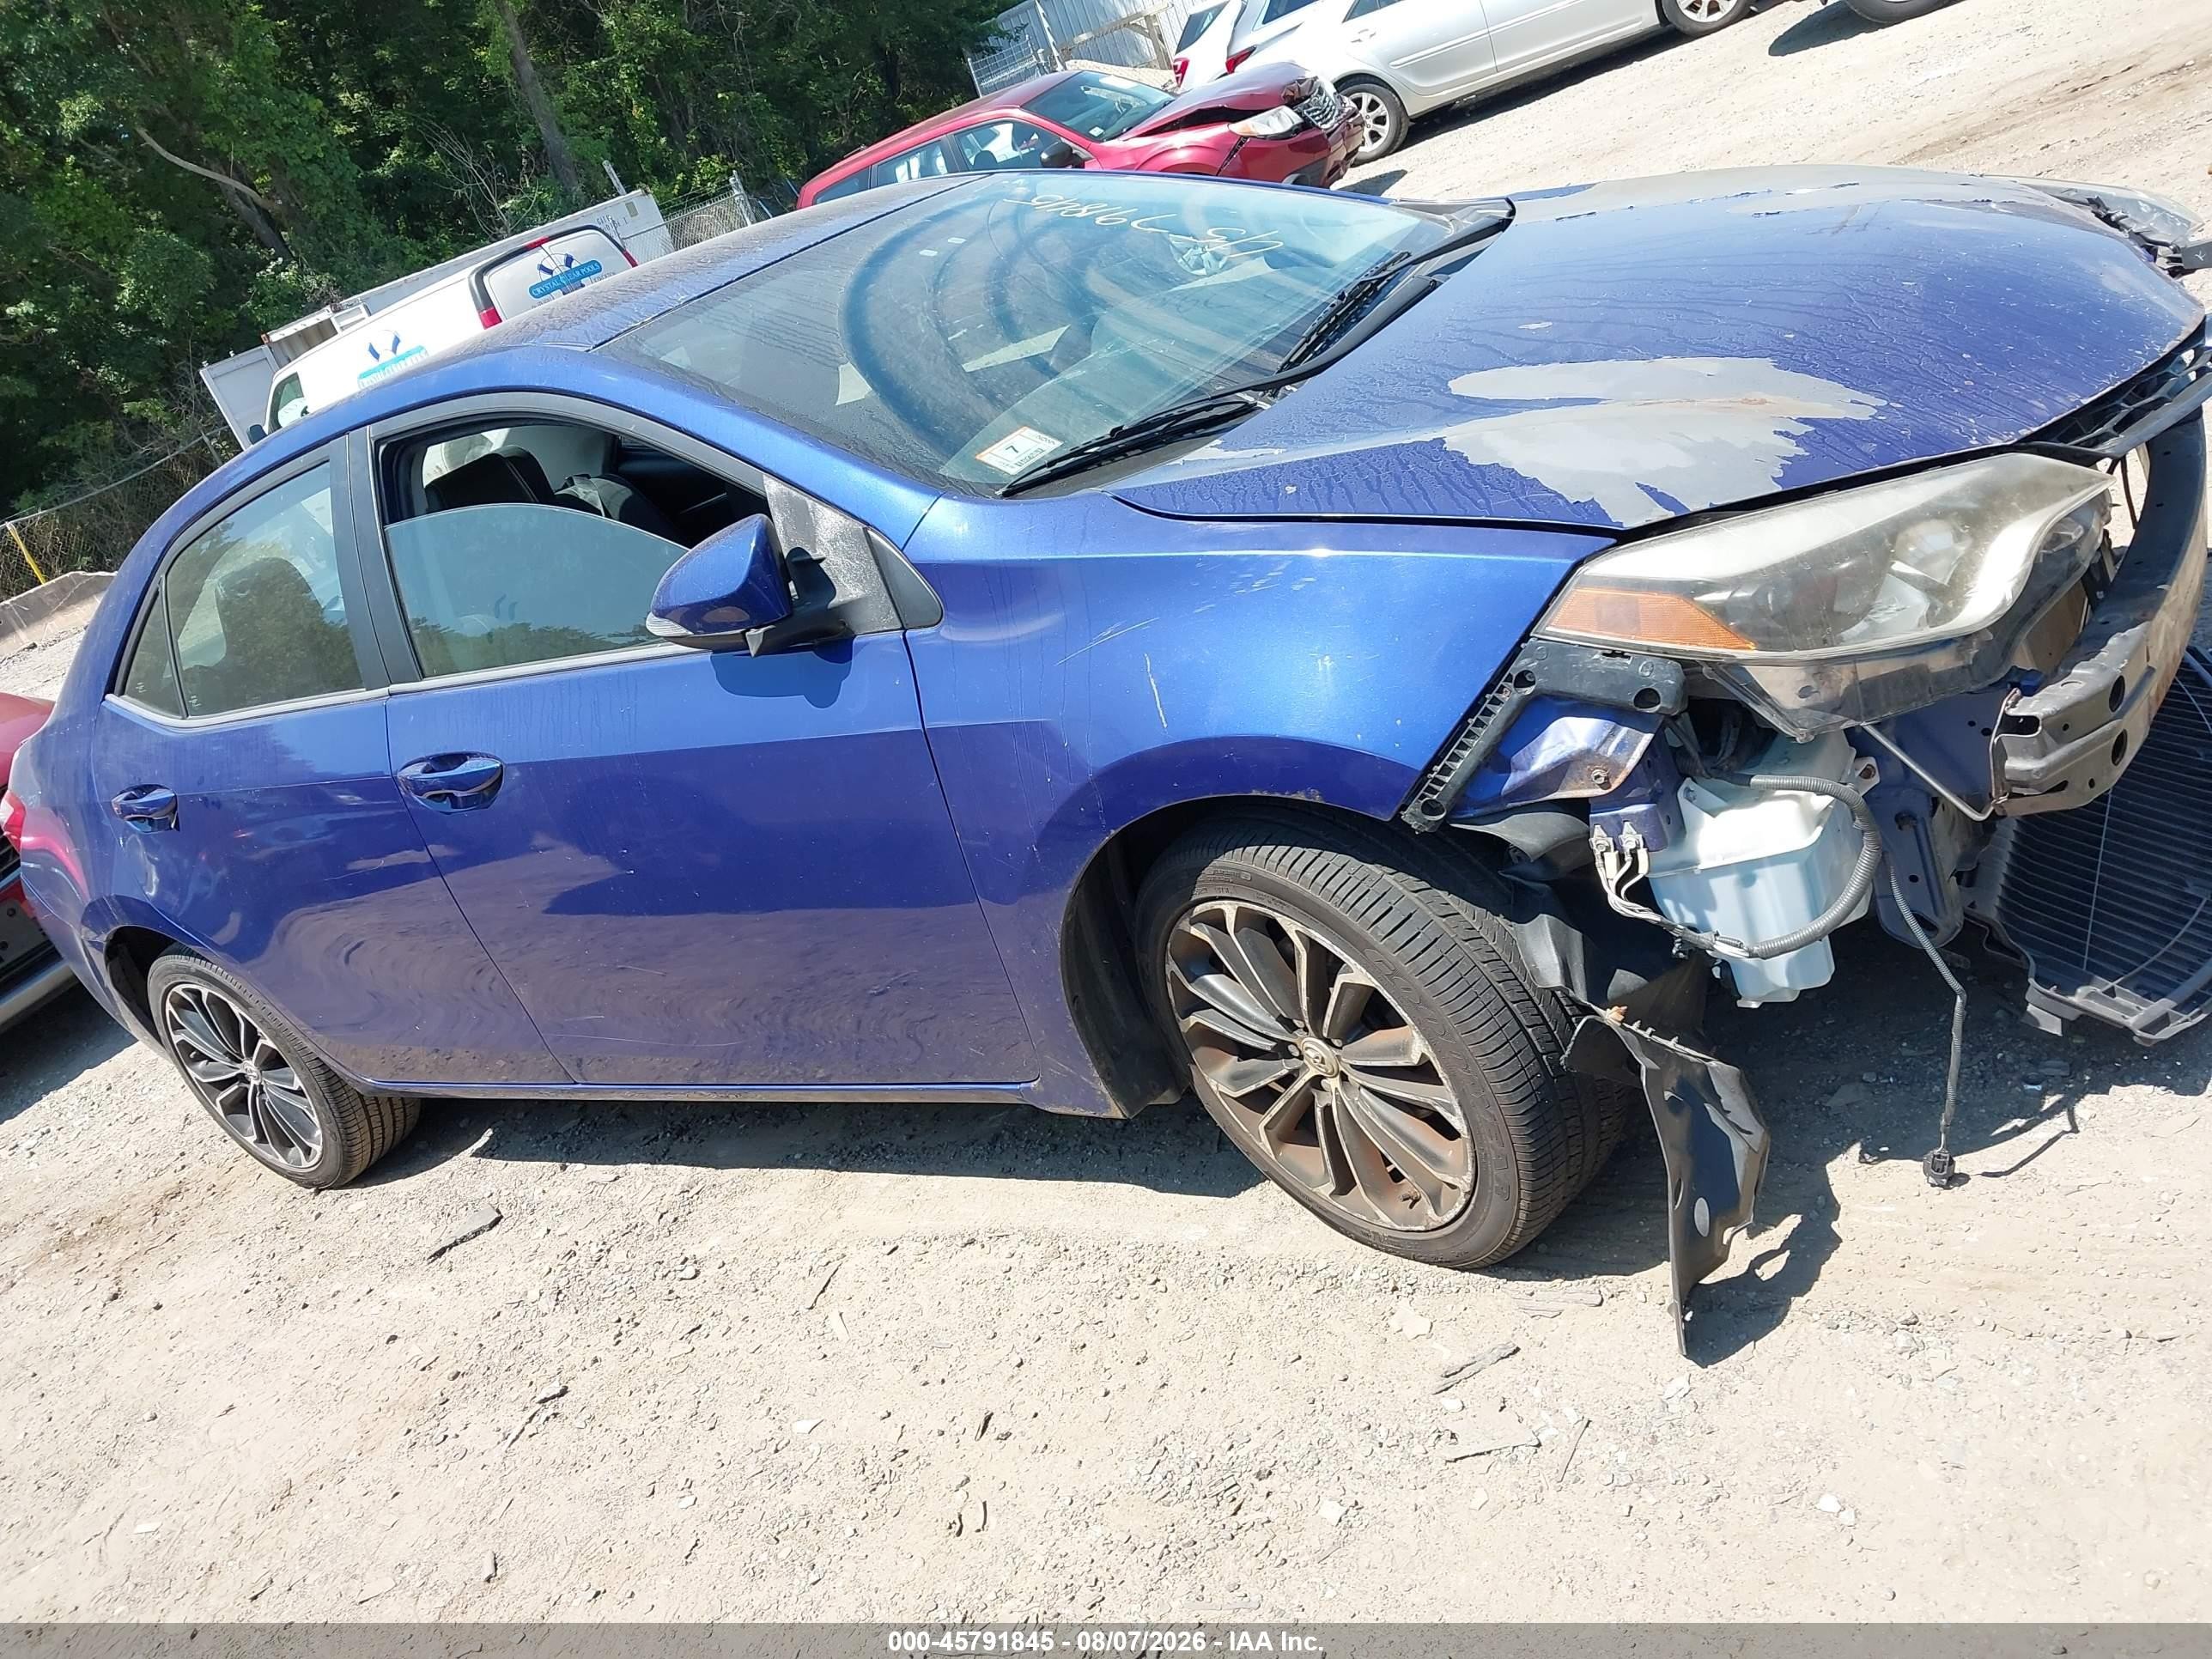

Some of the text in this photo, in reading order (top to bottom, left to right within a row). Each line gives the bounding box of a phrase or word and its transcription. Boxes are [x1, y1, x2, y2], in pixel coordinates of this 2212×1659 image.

[532, 279, 561, 296] CRYSTAL
[580, 262, 600, 276] POOLS
[1006, 445, 1019, 454] 7
